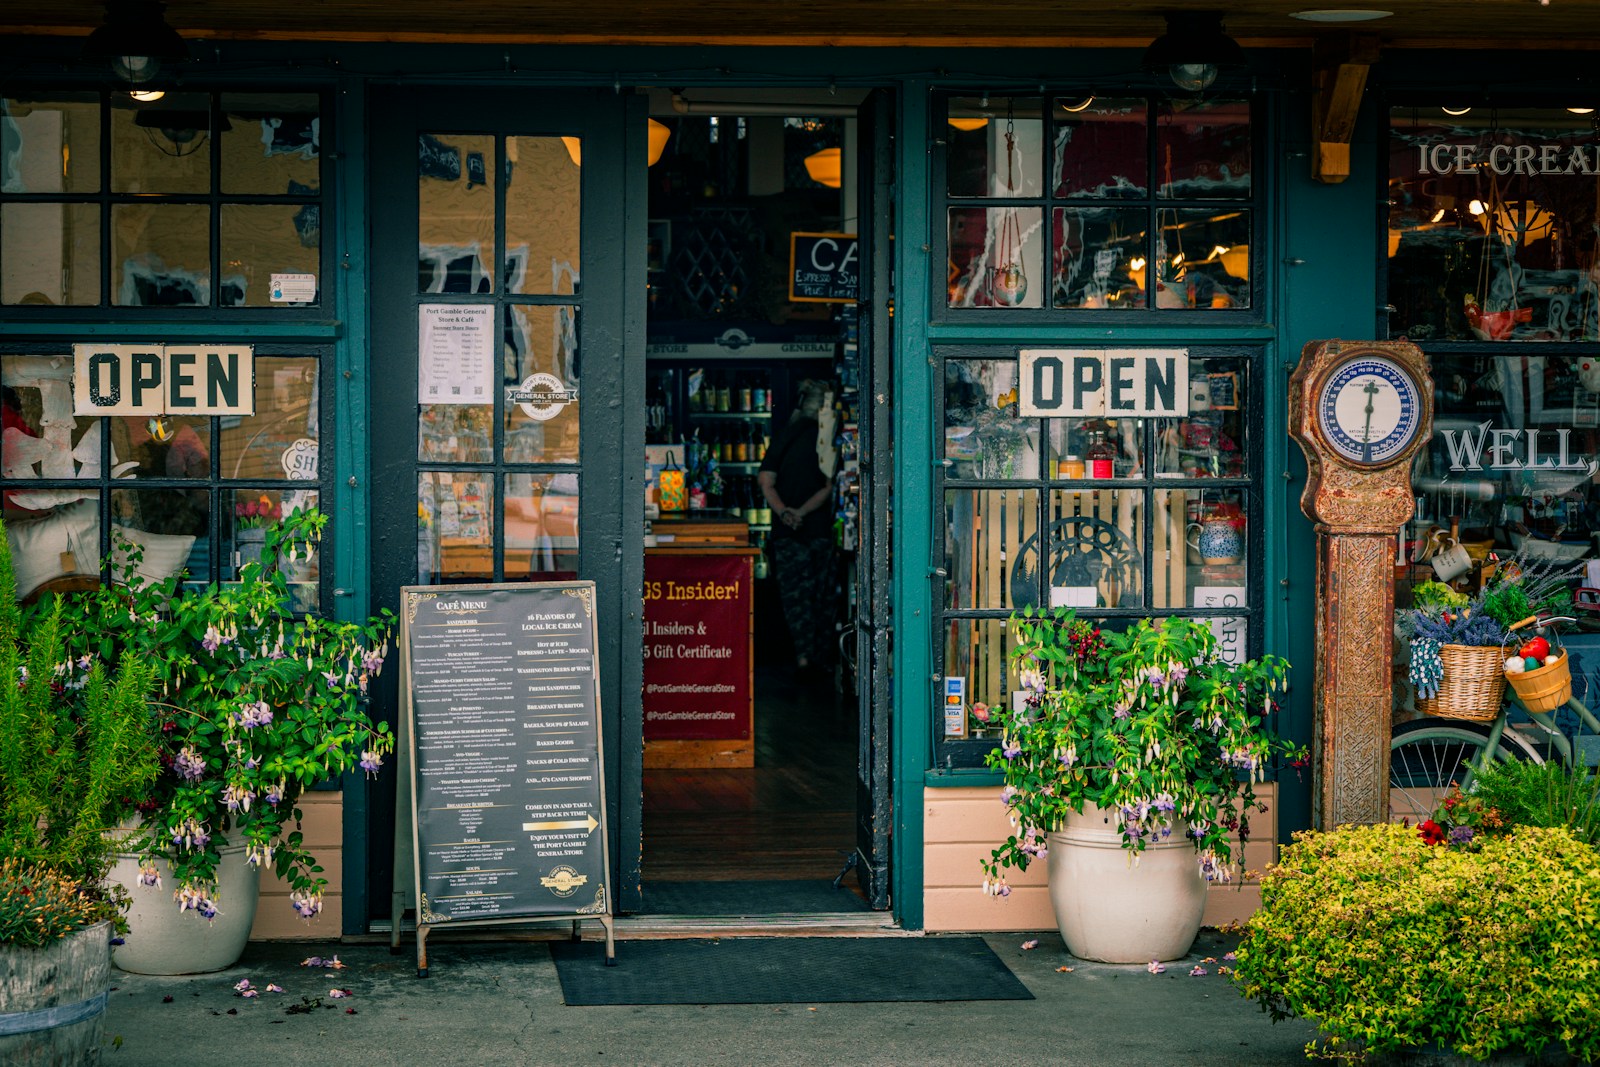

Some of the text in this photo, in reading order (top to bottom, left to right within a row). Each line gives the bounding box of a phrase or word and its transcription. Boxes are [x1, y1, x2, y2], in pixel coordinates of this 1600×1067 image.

[1418, 144, 1600, 178] ICE CREA
[781, 344, 832, 352] GENERAL
[89, 353, 239, 407] OPEN
[538, 376, 560, 390] GAMBLE
[1032, 356, 1175, 410] OPEN
[1441, 419, 1600, 477] WELL,
[293, 454, 315, 471] SH
[666, 581, 740, 600] Insider!
[436, 600, 487, 610] CAFÉ MENU
[653, 622, 694, 635] Insiders
[697, 621, 706, 635] &
[654, 644, 674, 658] Gift
[676, 644, 732, 658] Certificate
[646, 684, 736, 693] @PortGambleGeneralStore
[646, 711, 736, 720] @PortGambleGeneralStore
